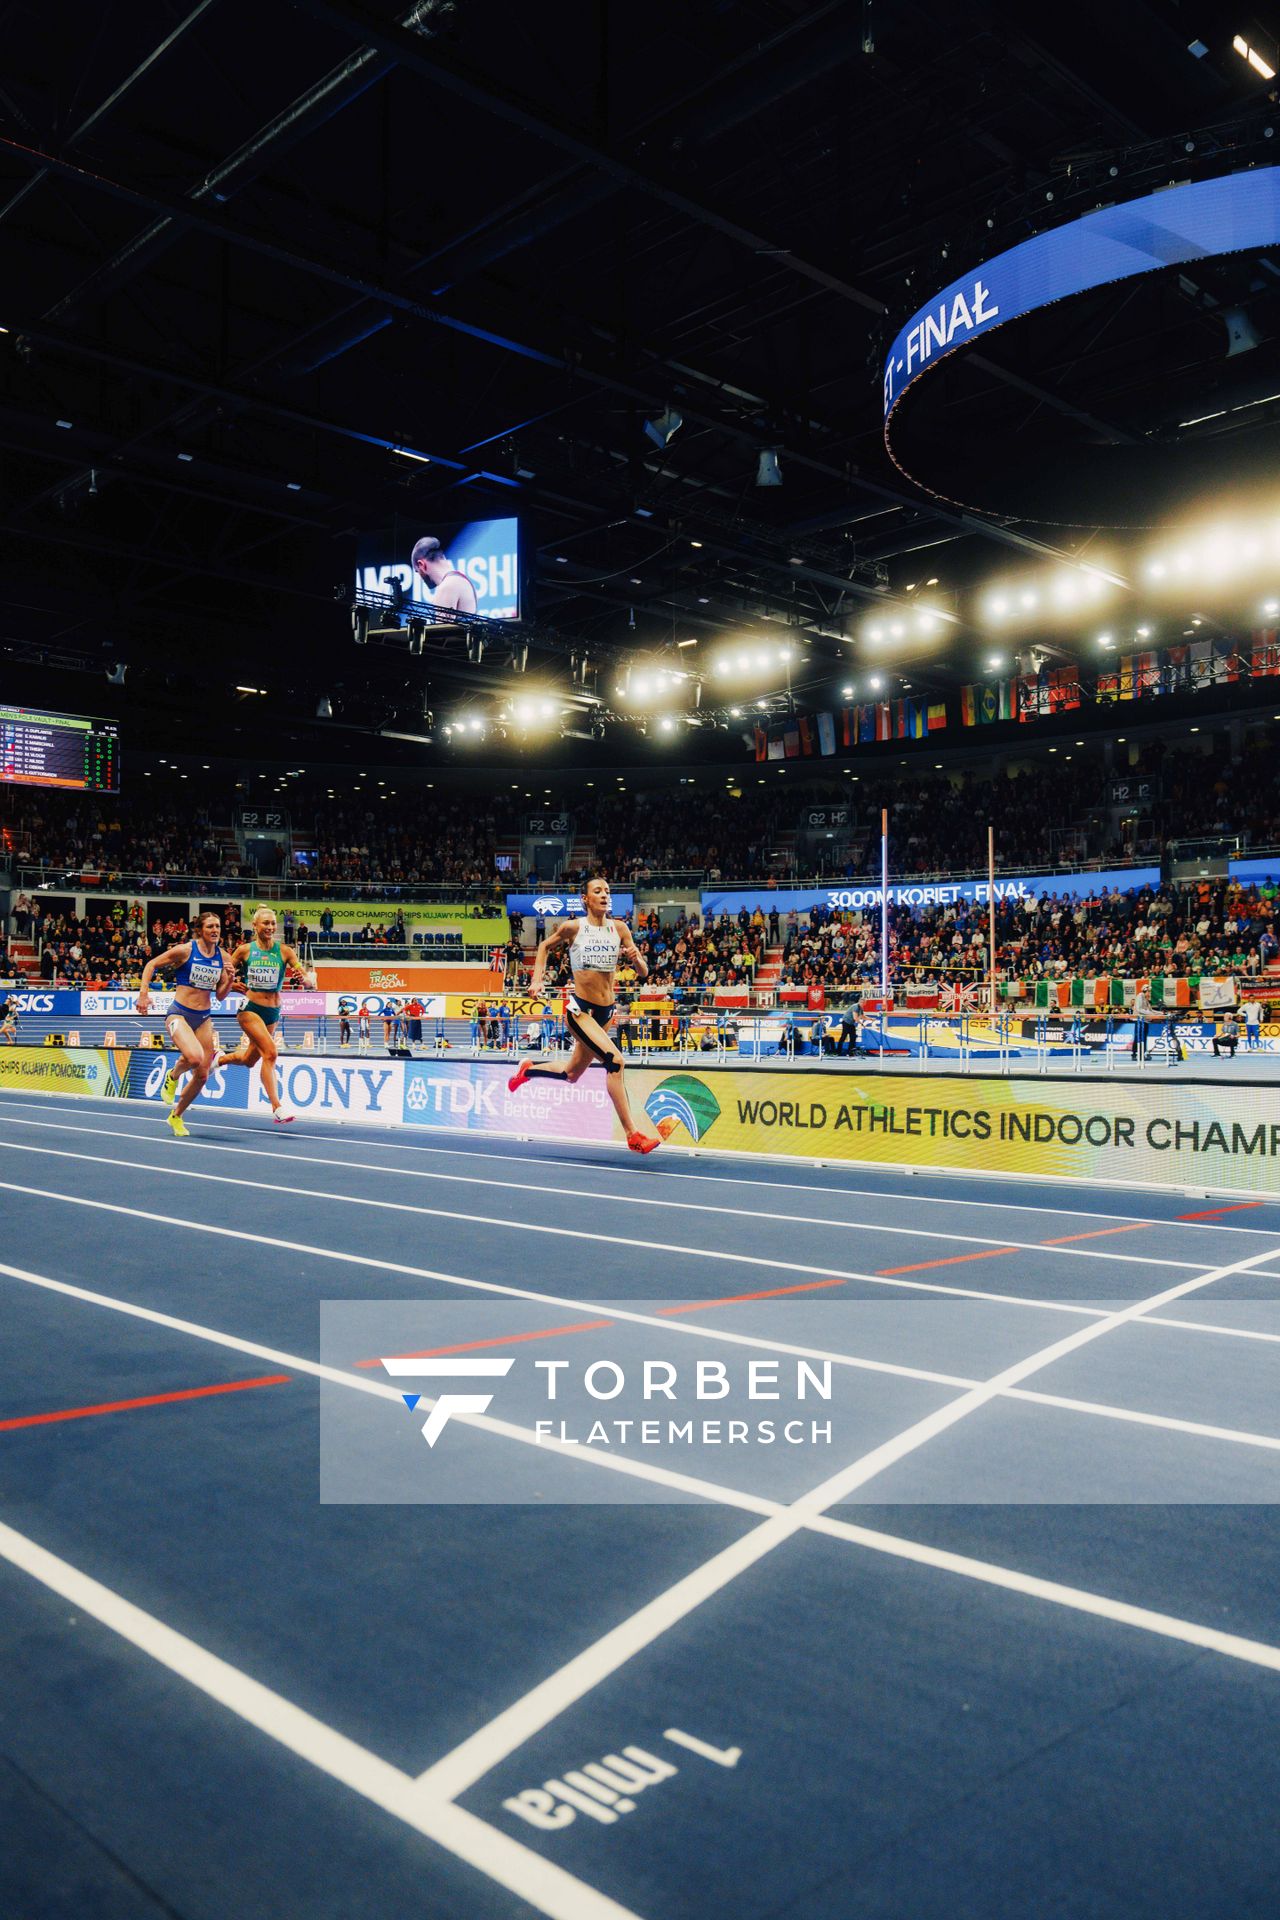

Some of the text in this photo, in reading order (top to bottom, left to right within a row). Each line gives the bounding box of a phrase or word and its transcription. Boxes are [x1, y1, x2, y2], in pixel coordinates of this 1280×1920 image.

[906, 280, 999, 375] FINAŁ
[1112, 786, 1129, 800] H2
[242, 813, 281, 825] E2 F2
[529, 820, 568, 831] F2 G2
[809, 812, 848, 825] G2 H2
[827, 889, 894, 908] 3000M
[897, 886, 961, 905] KOBIET
[975, 882, 1030, 901] FINAŁ
[370, 974, 398, 983] TRACK
[338, 995, 435, 1014] SONY
[462, 998, 549, 1017] SKO
[70, 1036, 77, 1046] 8
[107, 1036, 114, 1046] 7
[142, 1036, 149, 1046] 6
[1155, 1039, 1210, 1050] SONY
[21, 1061, 49, 1080] KUJAWY
[50, 1063, 86, 1079] POMORZE
[87, 1065, 98, 1080] 26
[259, 1063, 393, 1112] SONY
[427, 1078, 499, 1116] TDK
[504, 1100, 552, 1120] Better
[737, 1100, 827, 1129] WORLD
[834, 1104, 992, 1140] ATHLETICS
[1000, 1112, 1135, 1148] INDOOR
[663, 1728, 743, 1768] 1
[503, 1745, 679, 1830] mila
